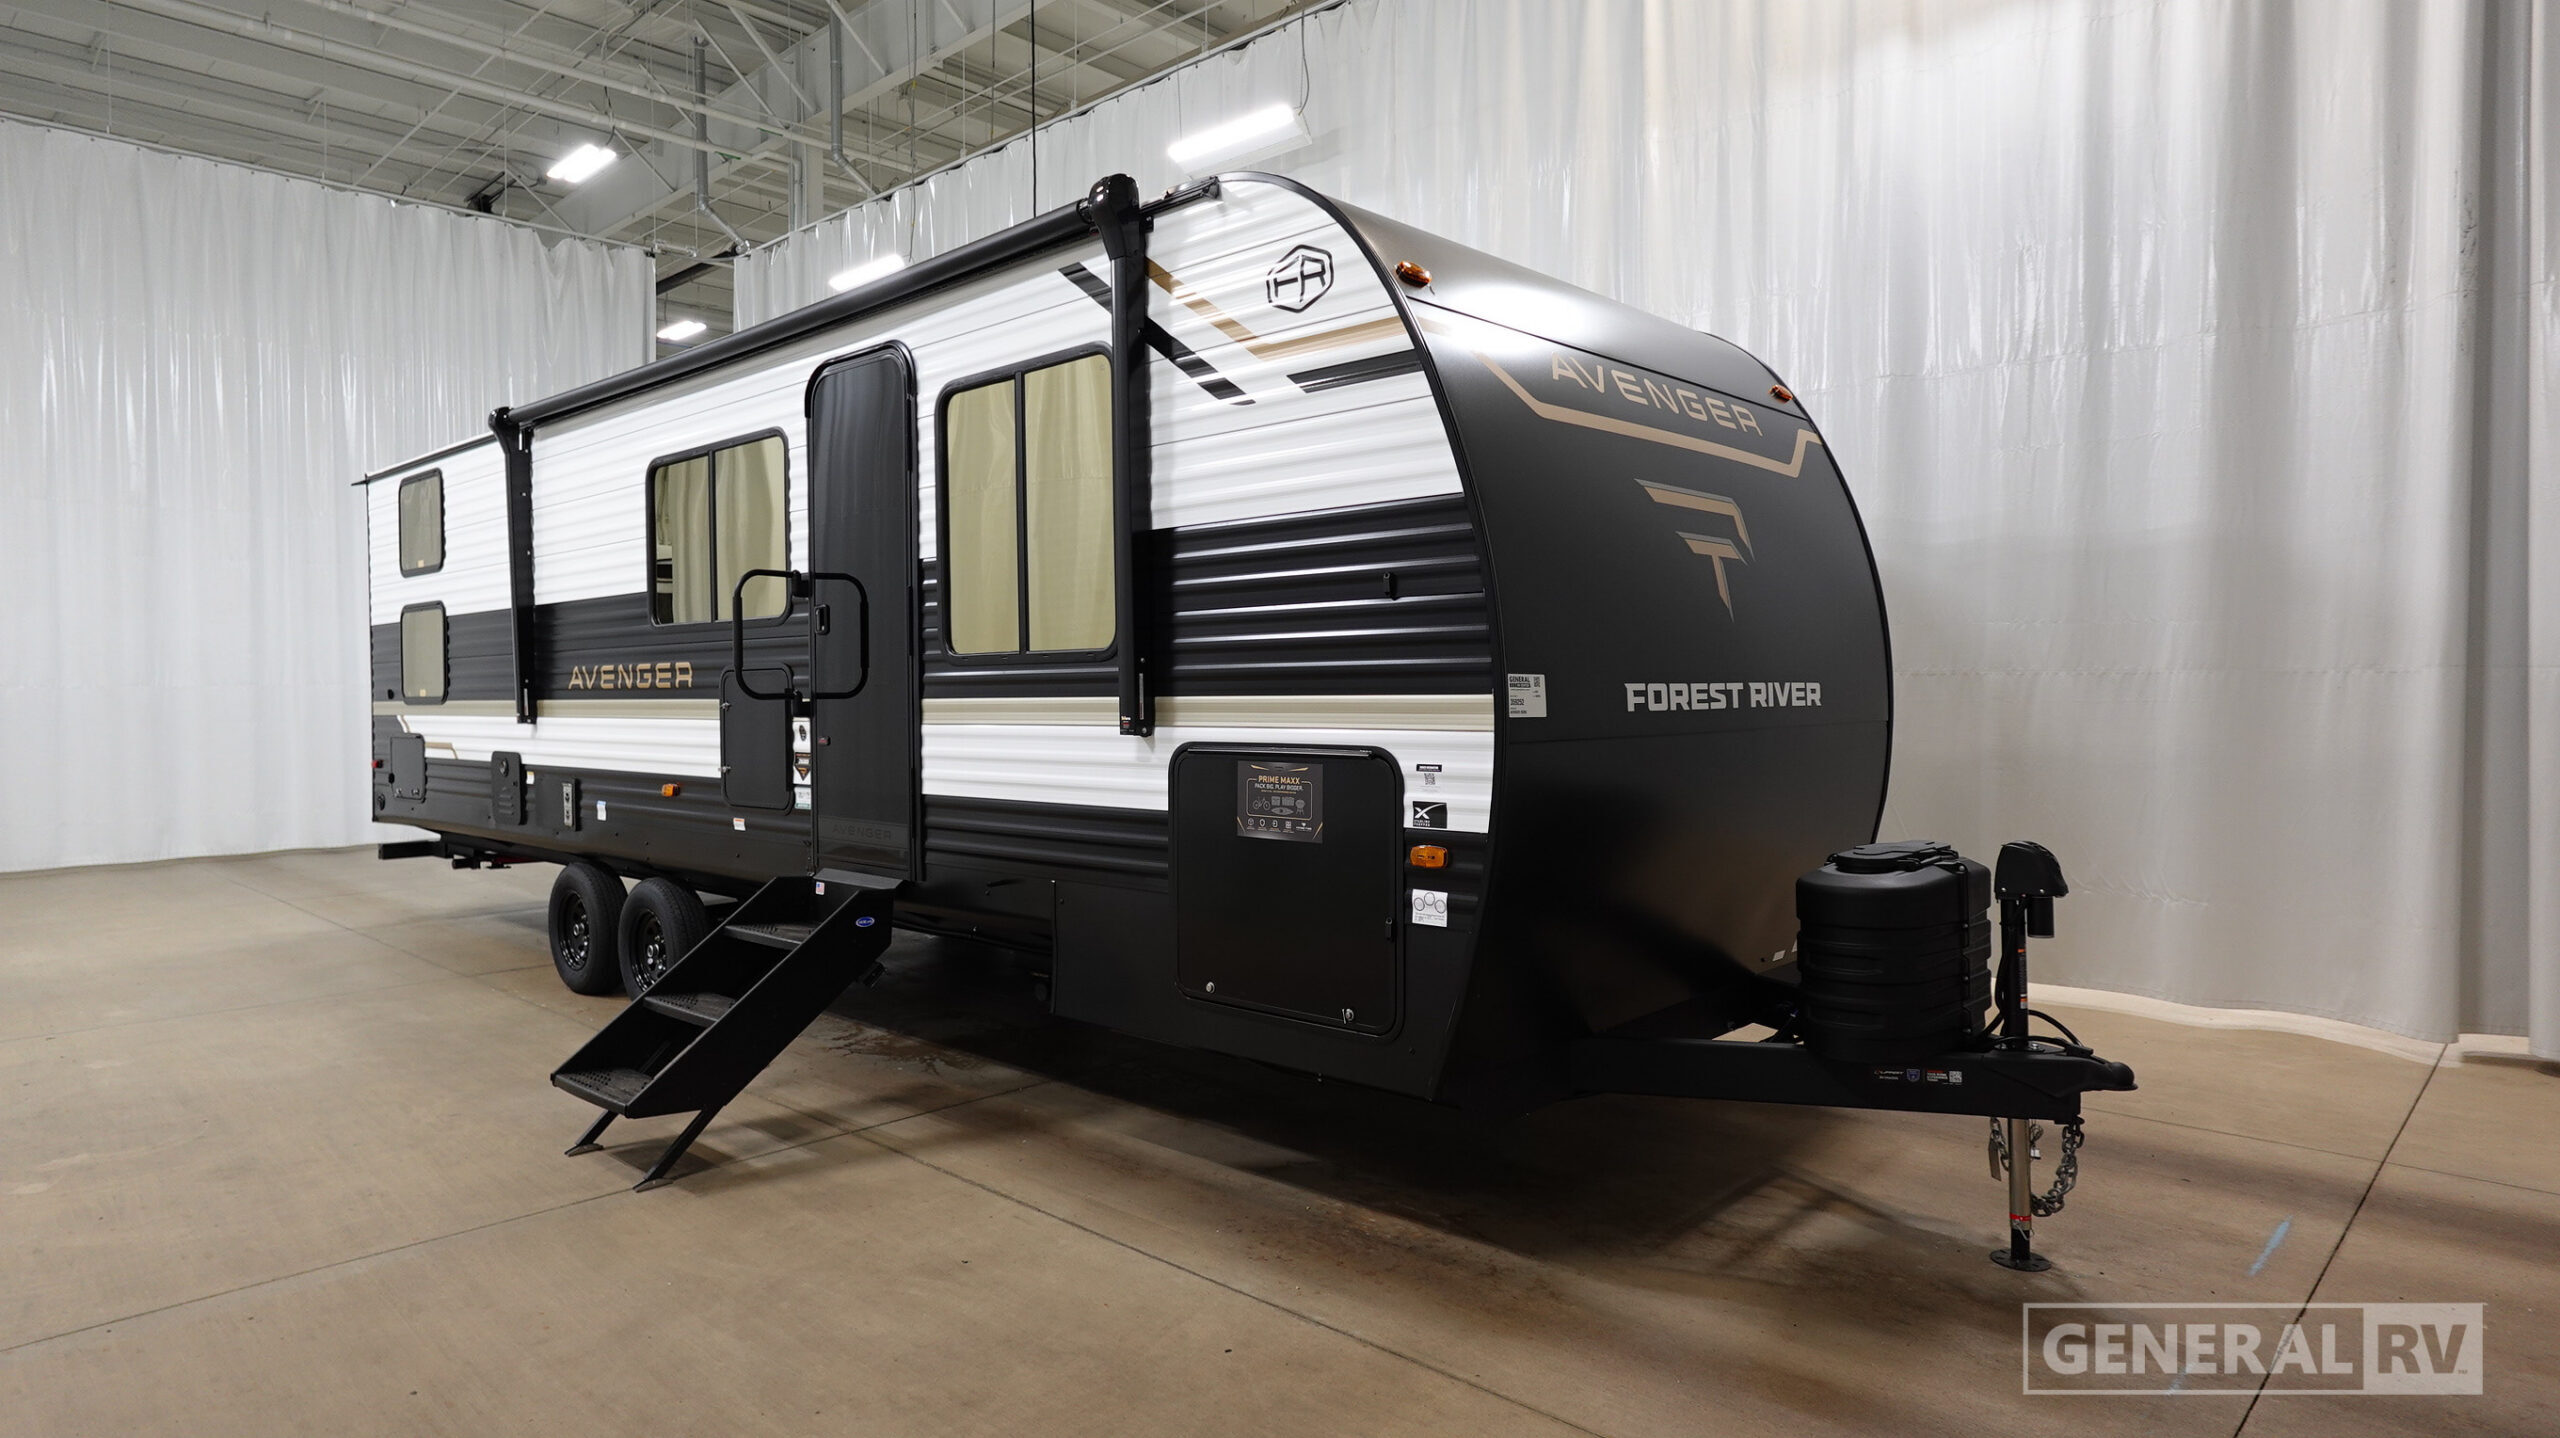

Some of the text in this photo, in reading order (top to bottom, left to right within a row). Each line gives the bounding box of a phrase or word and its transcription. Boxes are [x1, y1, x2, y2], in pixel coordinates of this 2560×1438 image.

[1551, 352, 1763, 437] AVENGER
[568, 661, 693, 690] AVENGER
[1624, 682, 1822, 712] FOREST RIVER
[1258, 775, 1300, 785] PRIME MAXX
